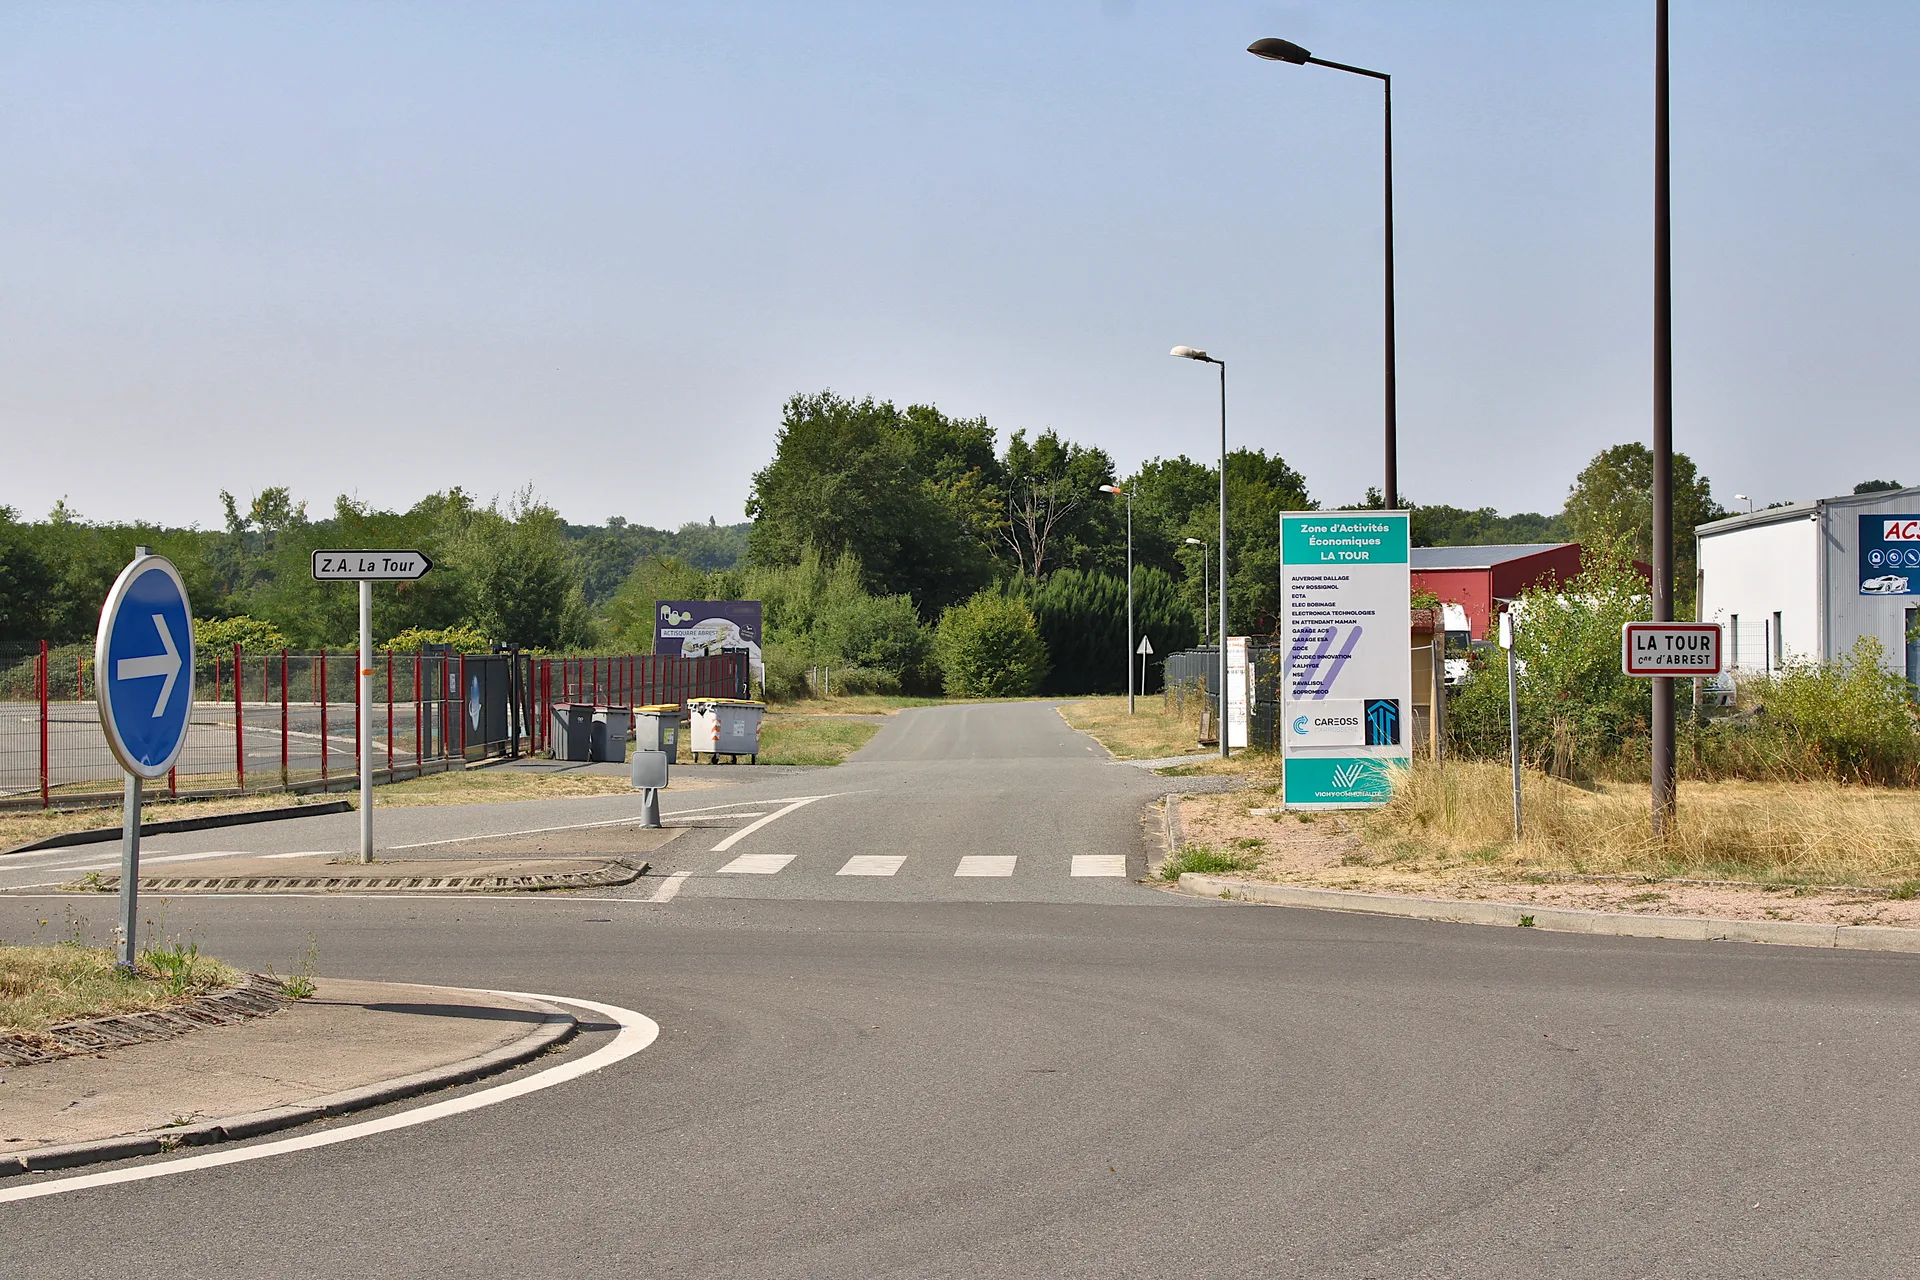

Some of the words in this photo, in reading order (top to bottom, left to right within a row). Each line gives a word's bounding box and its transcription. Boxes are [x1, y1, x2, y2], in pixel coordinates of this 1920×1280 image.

[1301, 524, 1327, 533] Zone
[1330, 523, 1389, 533] d'Activités
[1309, 535, 1381, 547] Économiques
[1320, 552, 1336, 560] LA
[1338, 551, 1369, 560] TOUR
[321, 559, 352, 572] Z.A.
[358, 558, 375, 572] La
[382, 558, 415, 572] Tour
[1637, 635, 1657, 650] LA
[1665, 635, 1710, 650] TOUR
[1656, 654, 1710, 664] d'ABREST
